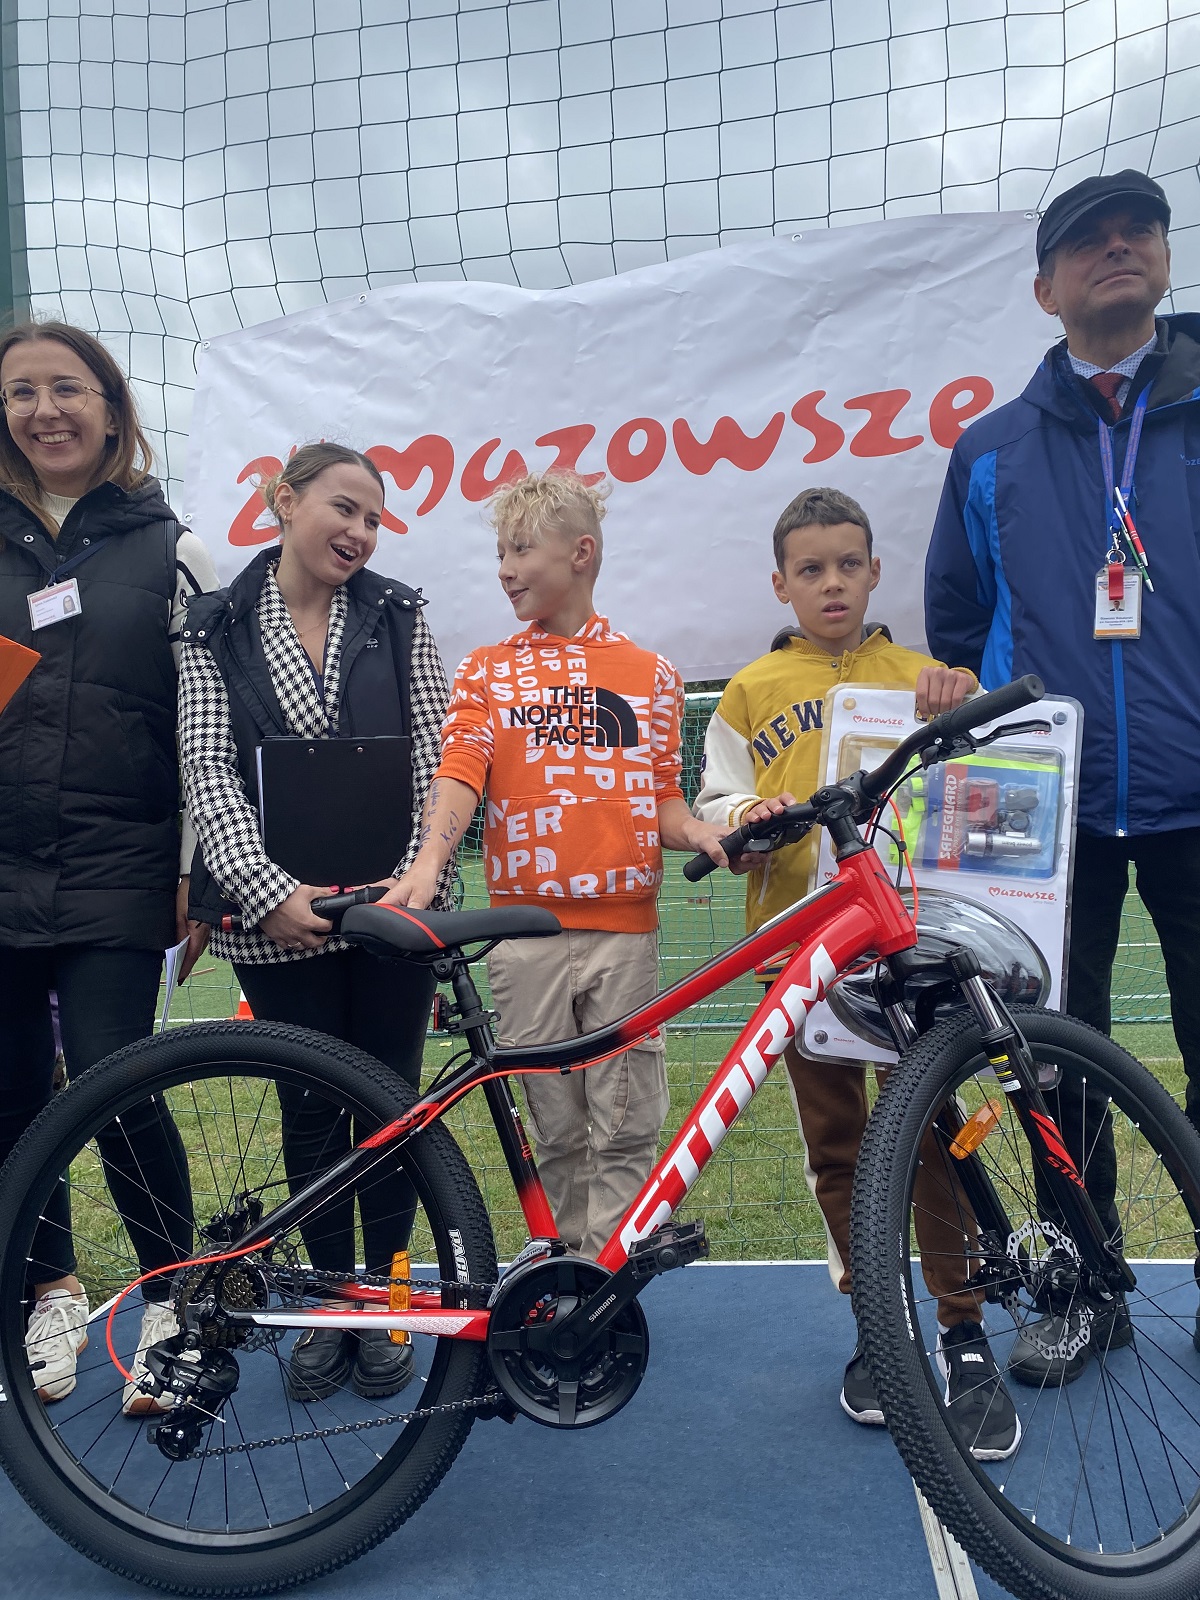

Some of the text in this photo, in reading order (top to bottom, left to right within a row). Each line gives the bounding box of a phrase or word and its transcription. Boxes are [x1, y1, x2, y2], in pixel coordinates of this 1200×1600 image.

[548, 686, 595, 705] THE
[509, 705, 595, 727] NORTH
[535, 725, 595, 747] FACE
[752, 698, 825, 768] NEW
[940, 774, 957, 860] SAFEGUARD
[619, 942, 837, 1256] STORM
[588, 1293, 617, 1323] SHIMANO
